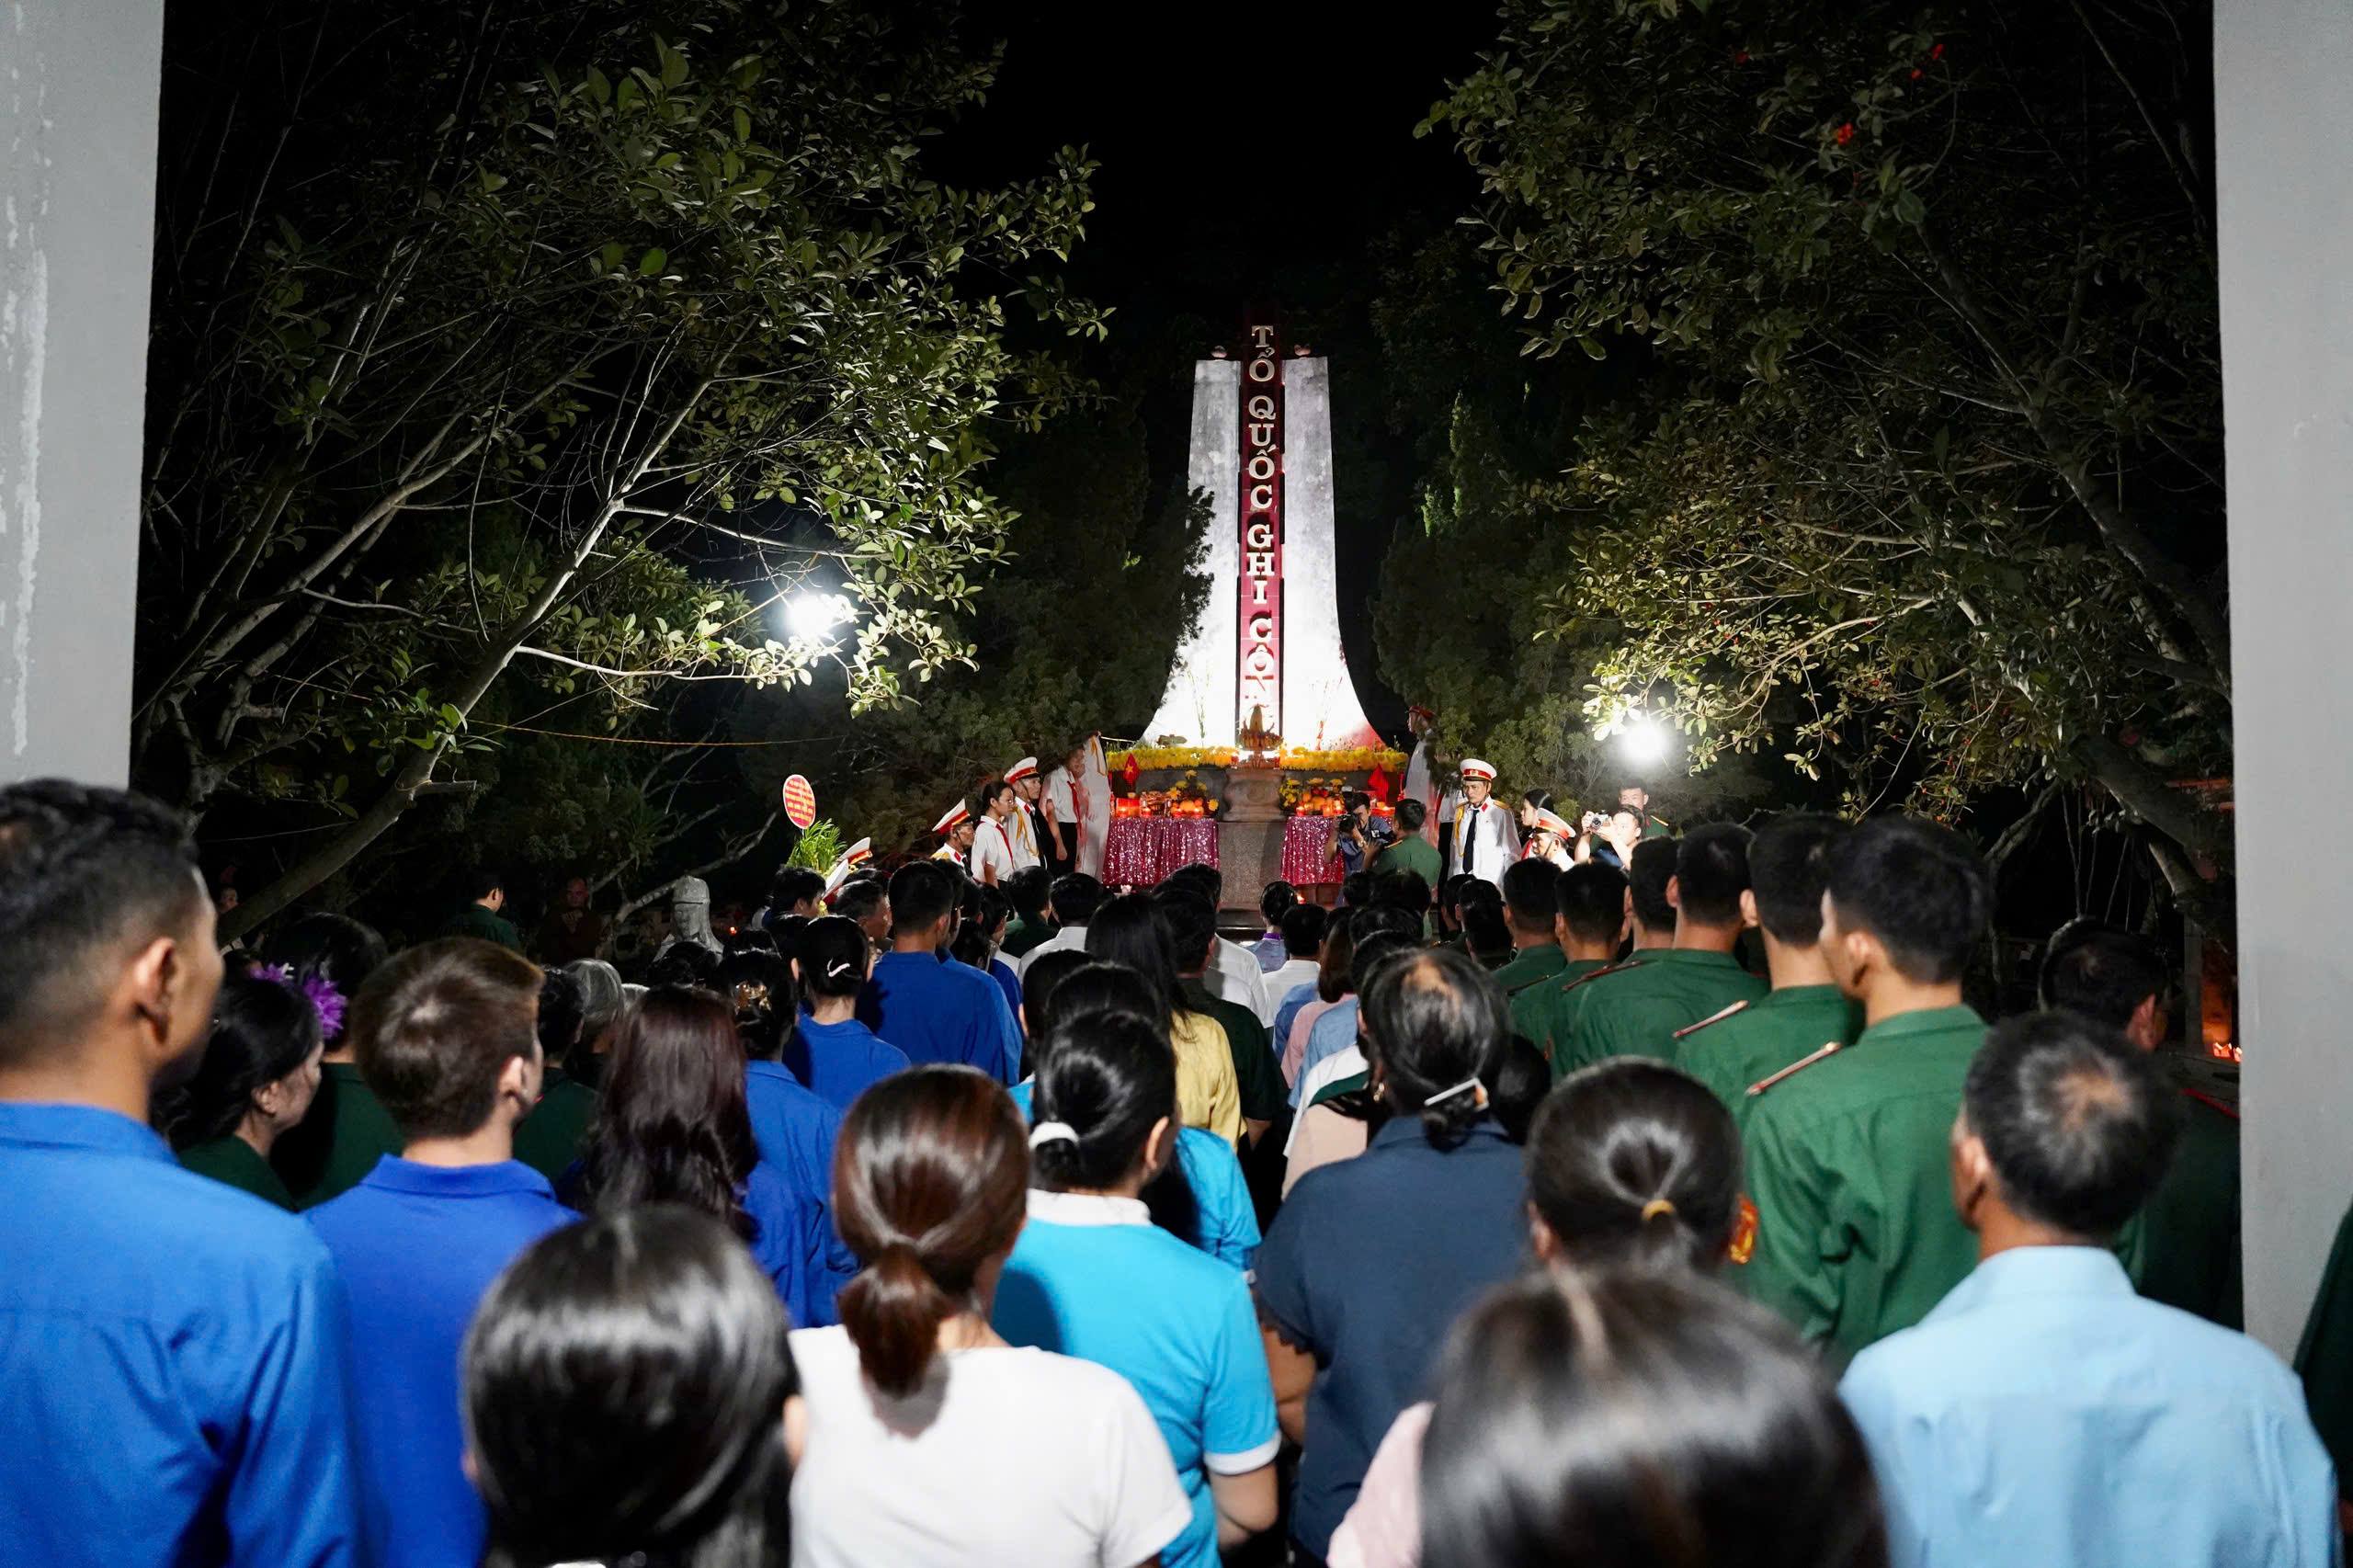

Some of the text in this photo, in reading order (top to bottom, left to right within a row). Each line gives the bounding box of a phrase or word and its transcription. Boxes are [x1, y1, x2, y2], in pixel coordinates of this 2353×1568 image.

[1248, 325, 1276, 382] TỔ
[1248, 395, 1277, 509] QUỐC
[1246, 524, 1275, 605] GHI
